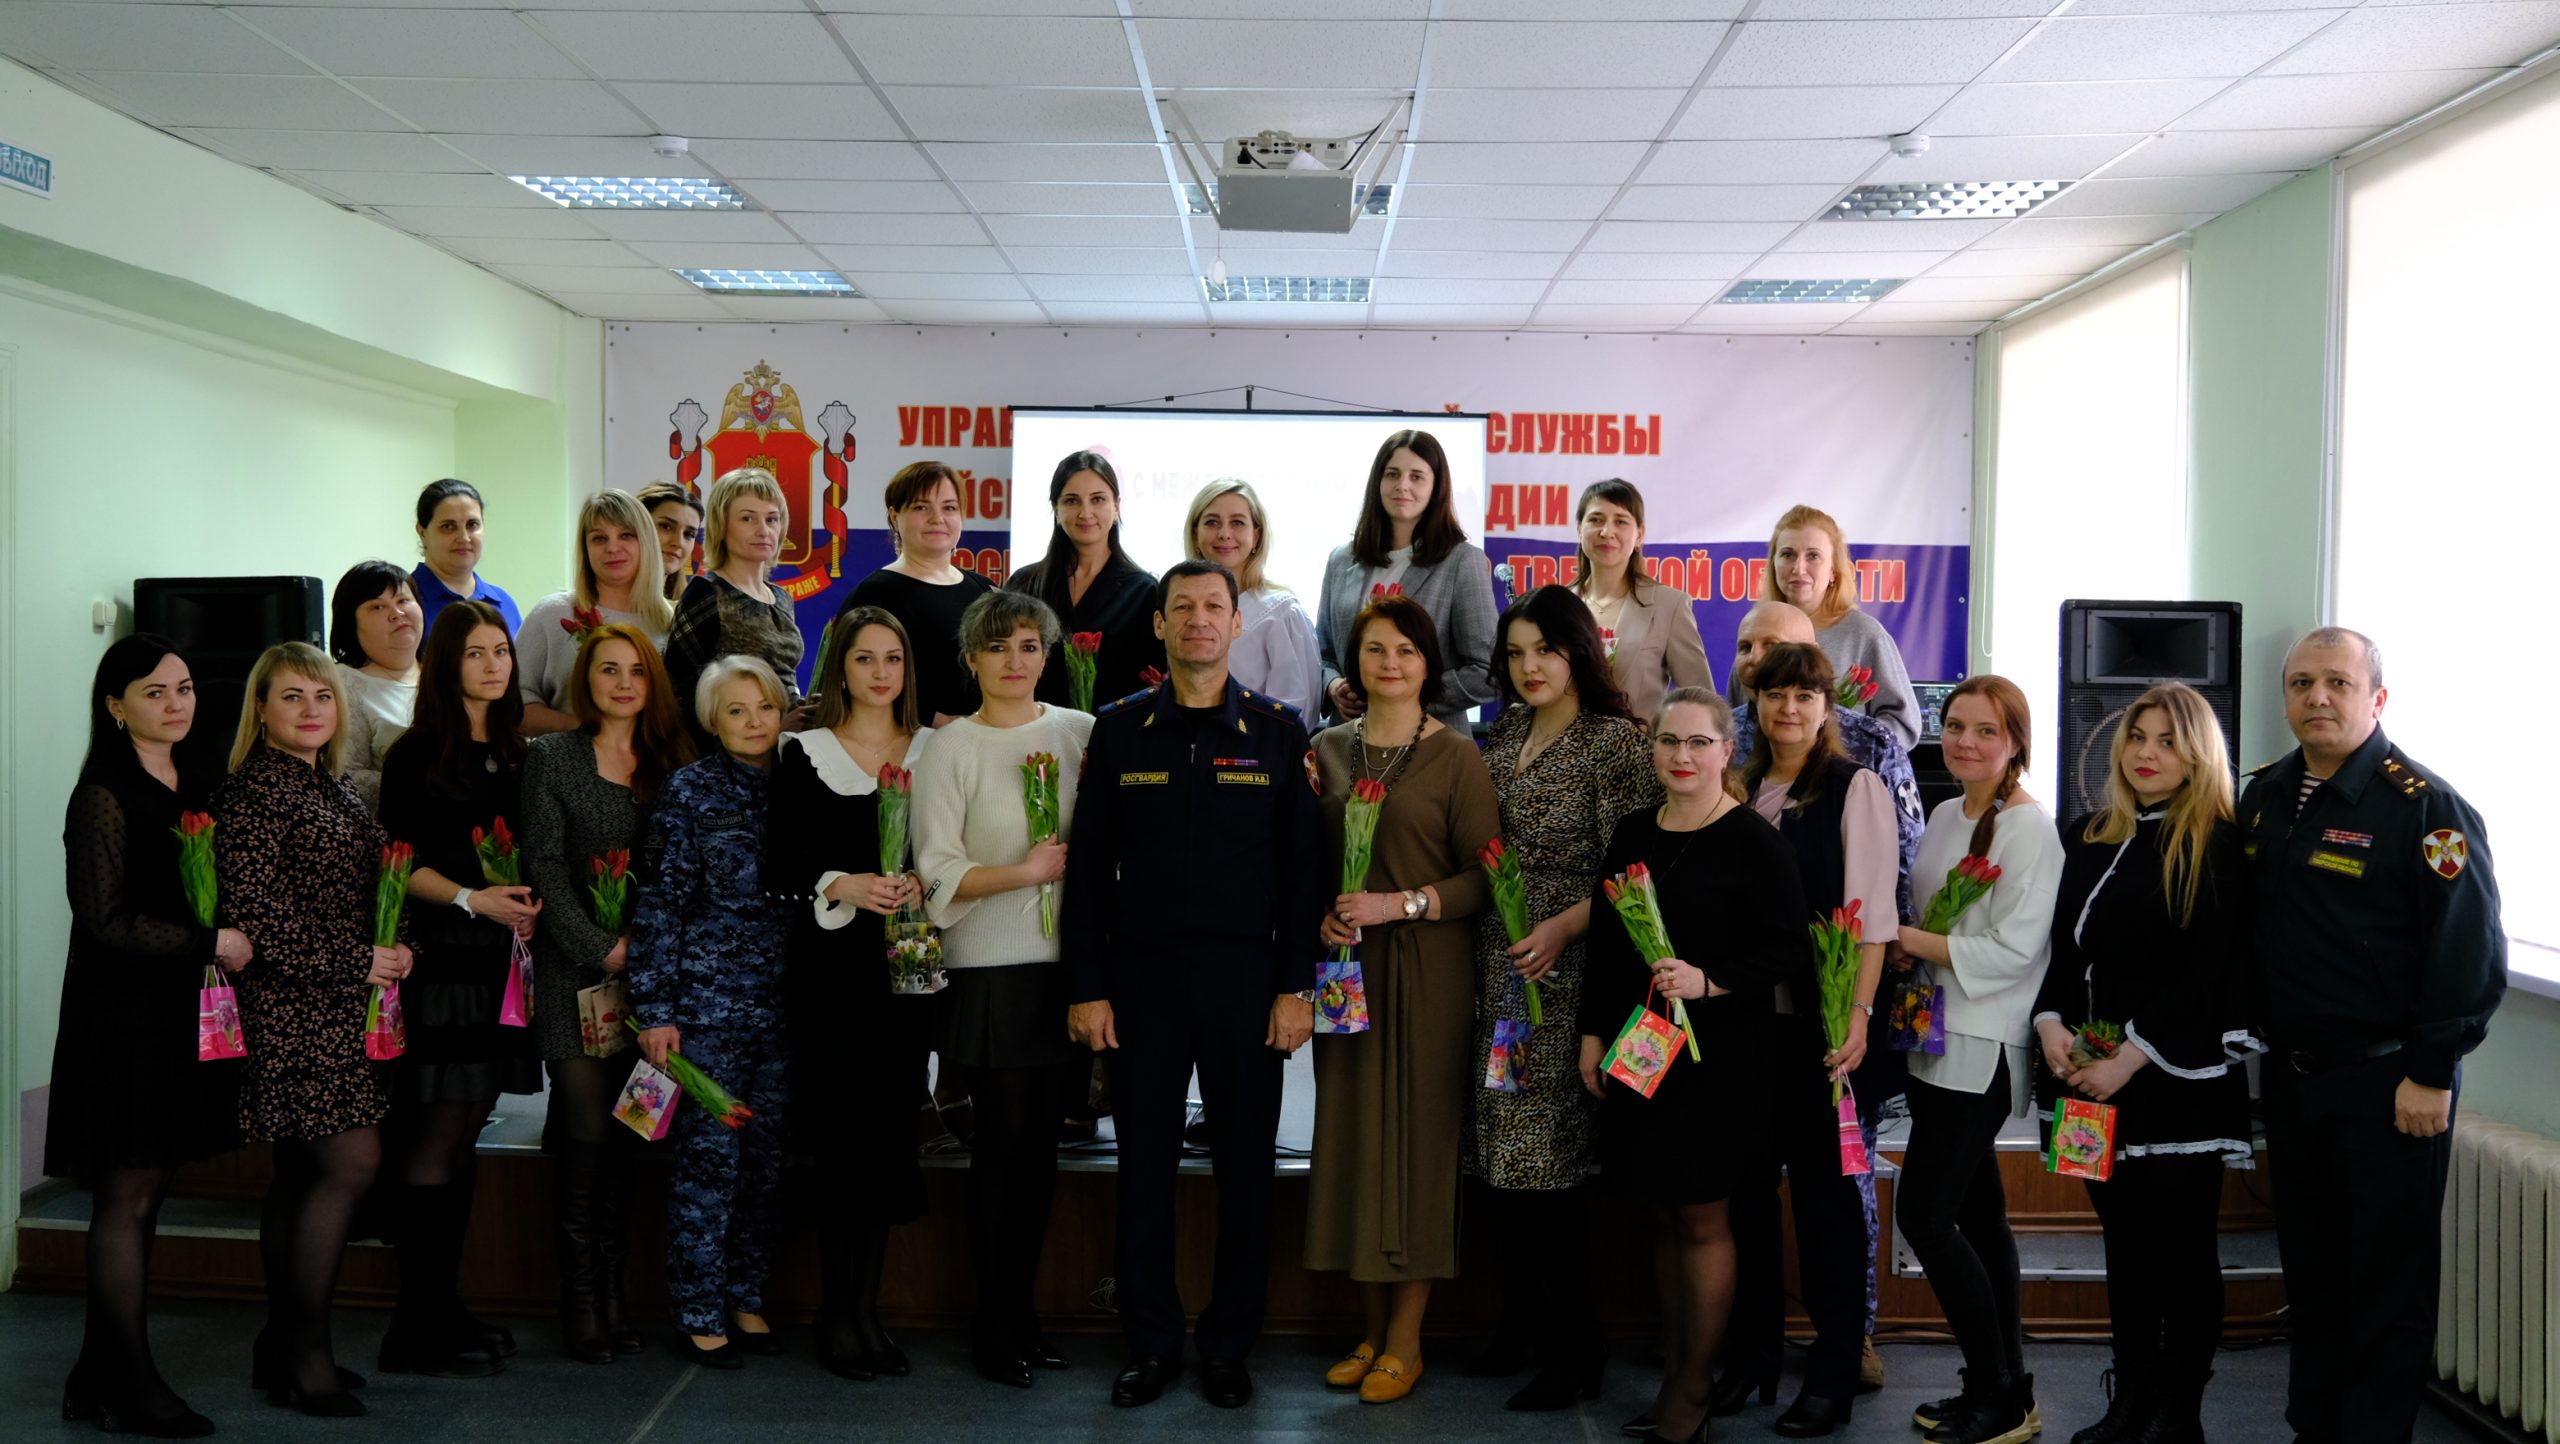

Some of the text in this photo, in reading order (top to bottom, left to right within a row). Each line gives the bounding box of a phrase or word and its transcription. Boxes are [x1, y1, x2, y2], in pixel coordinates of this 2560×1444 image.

[0, 145, 47, 189] ЫХОД
[897, 405, 1013, 447] УПРАВ
[1486, 411, 1661, 456] СЛУЖБЫ
[1485, 483, 1568, 532] ДИИ
[784, 575, 821, 597] РАЖЕ
[1720, 557, 1905, 603] ОБТИ
